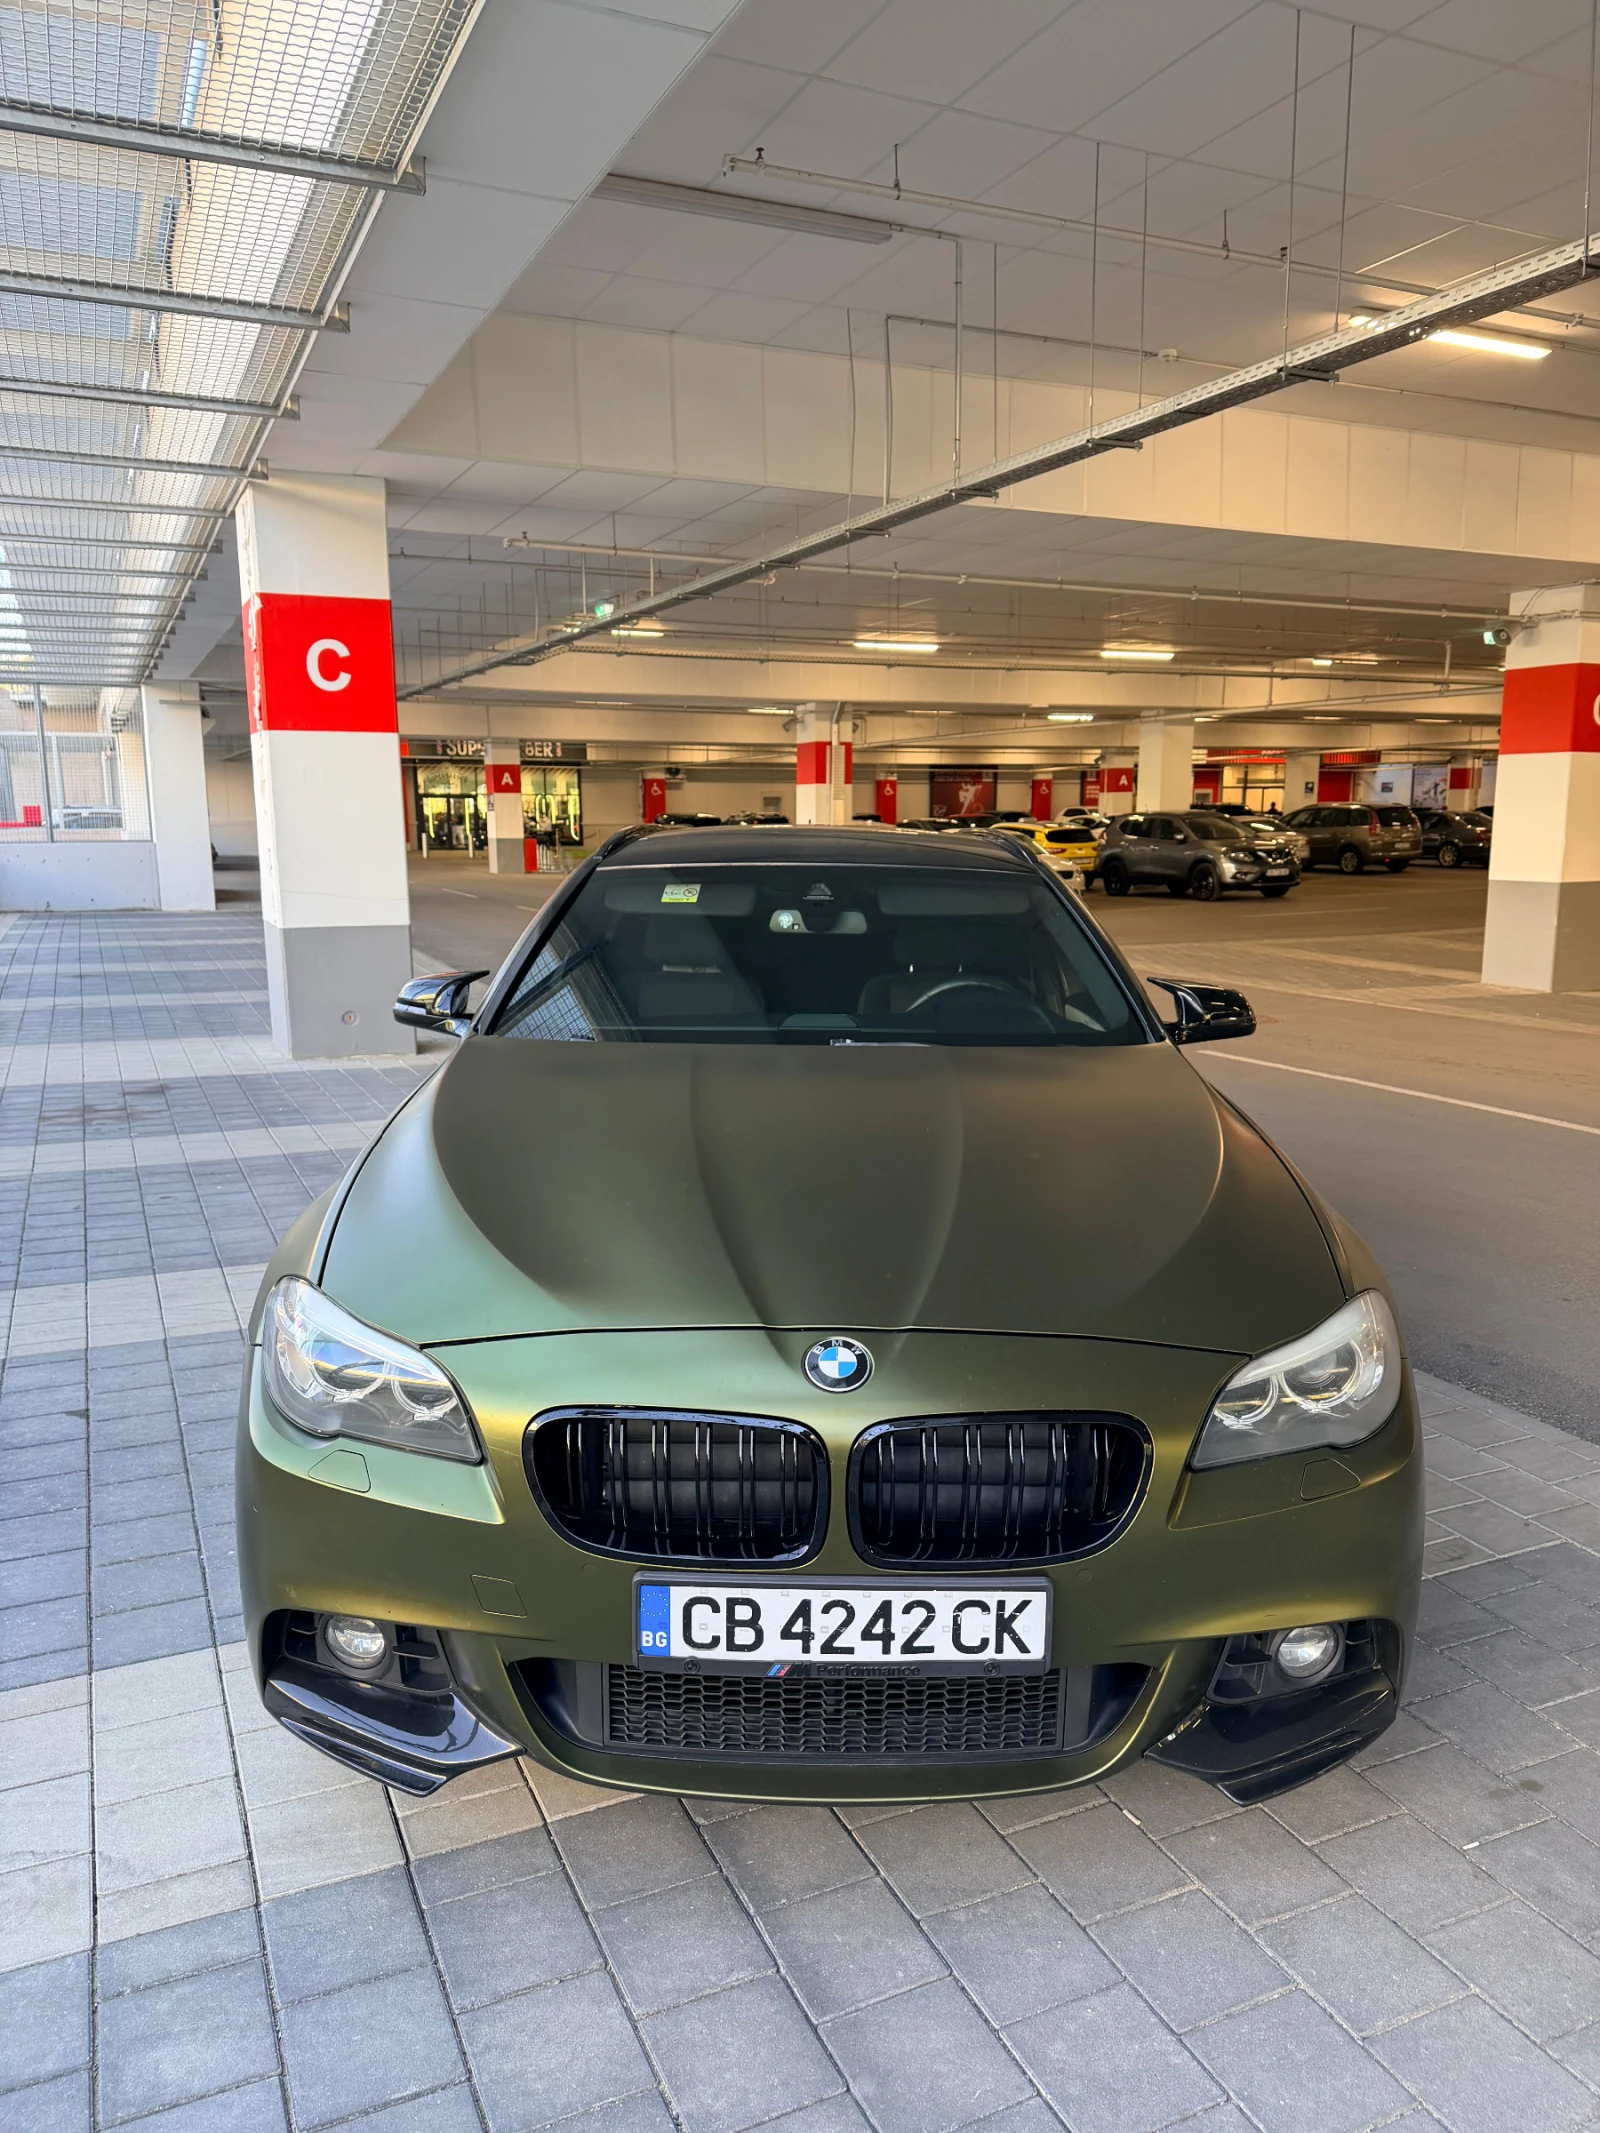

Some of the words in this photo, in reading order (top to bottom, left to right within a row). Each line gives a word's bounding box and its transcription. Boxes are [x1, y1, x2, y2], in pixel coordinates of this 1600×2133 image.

[306, 638, 352, 692] C
[501, 772, 514, 785] A
[1119, 774, 1129, 786] A
[811, 1340, 863, 1355] BMW
[641, 1631, 668, 1648] BG
[682, 1596, 764, 1653] CB
[780, 1599, 936, 1655] 4242
[951, 1599, 1033, 1655] CK
[816, 1663, 921, 1677] Performance
